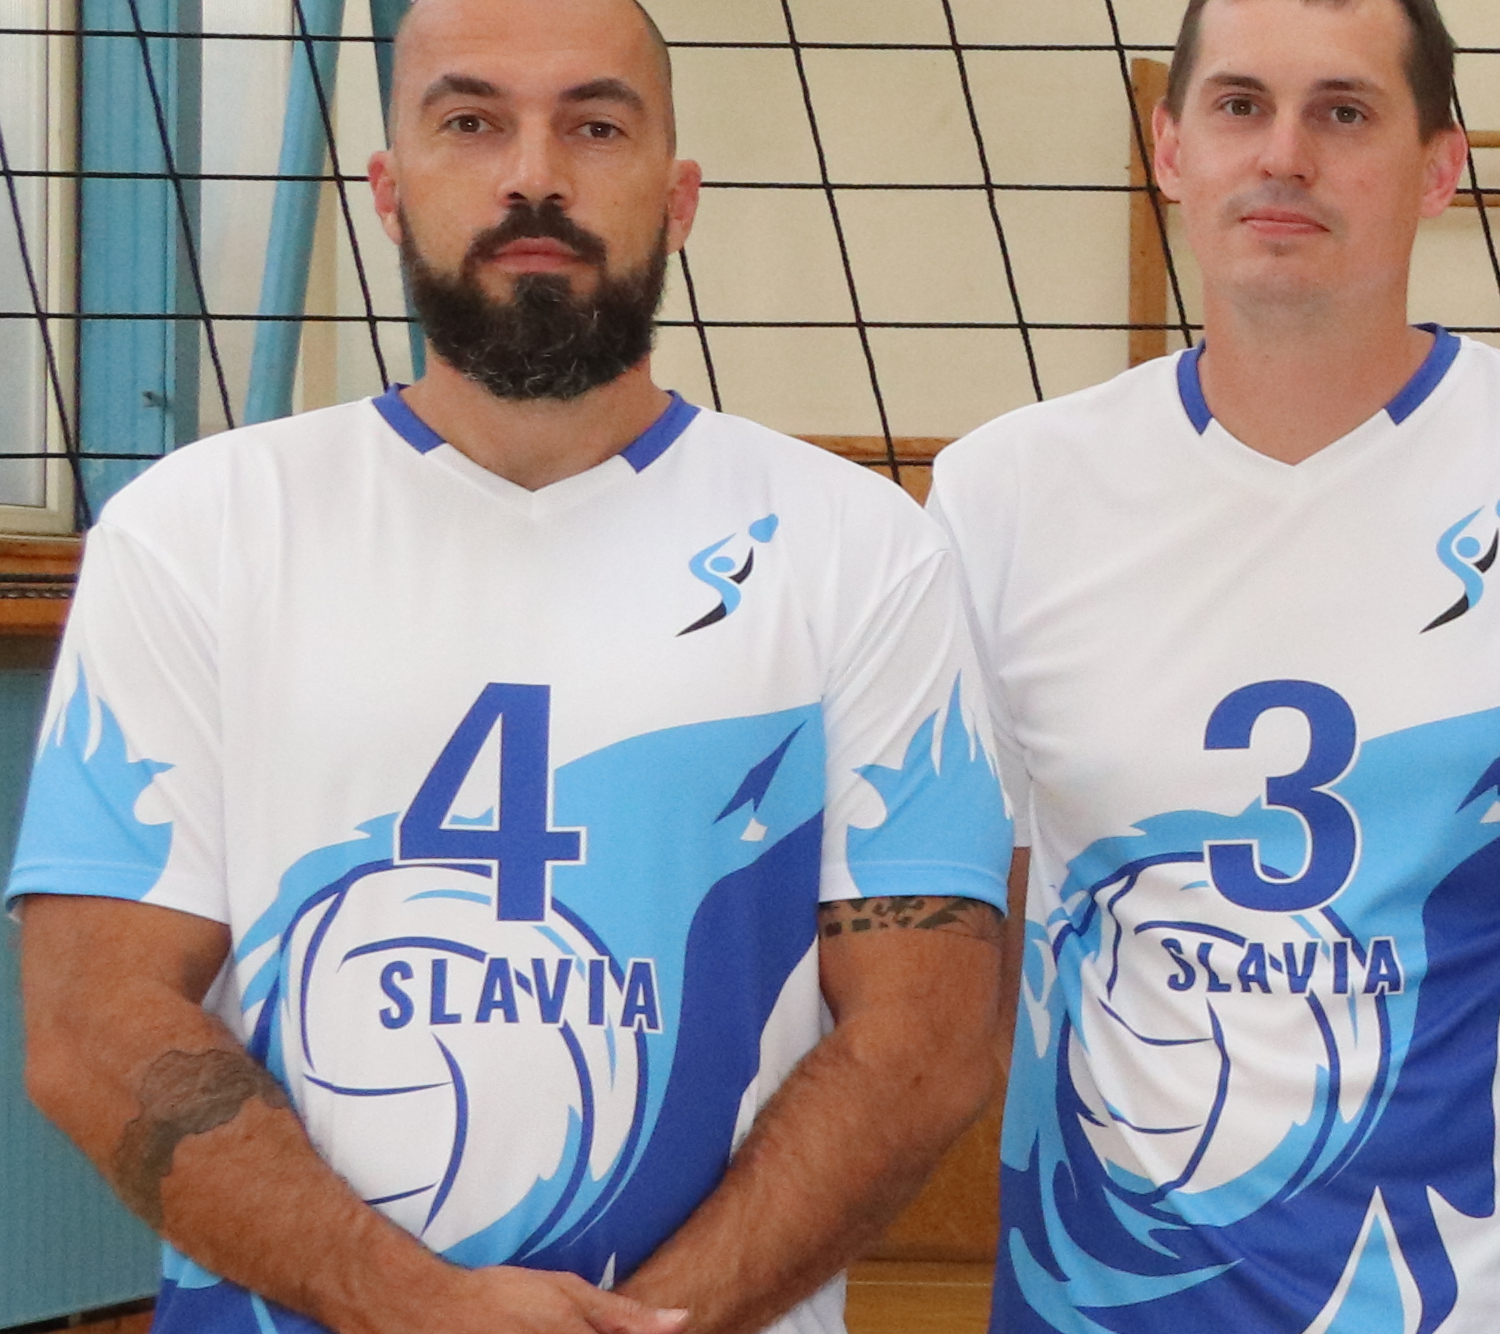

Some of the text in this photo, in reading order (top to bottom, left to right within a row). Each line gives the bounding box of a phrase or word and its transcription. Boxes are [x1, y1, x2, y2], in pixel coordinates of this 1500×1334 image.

[398, 682, 581, 922] 4
[1203, 680, 1358, 911] 3
[379, 957, 661, 1032] SLAVIA
[1167, 937, 1402, 994] SLAVIA
